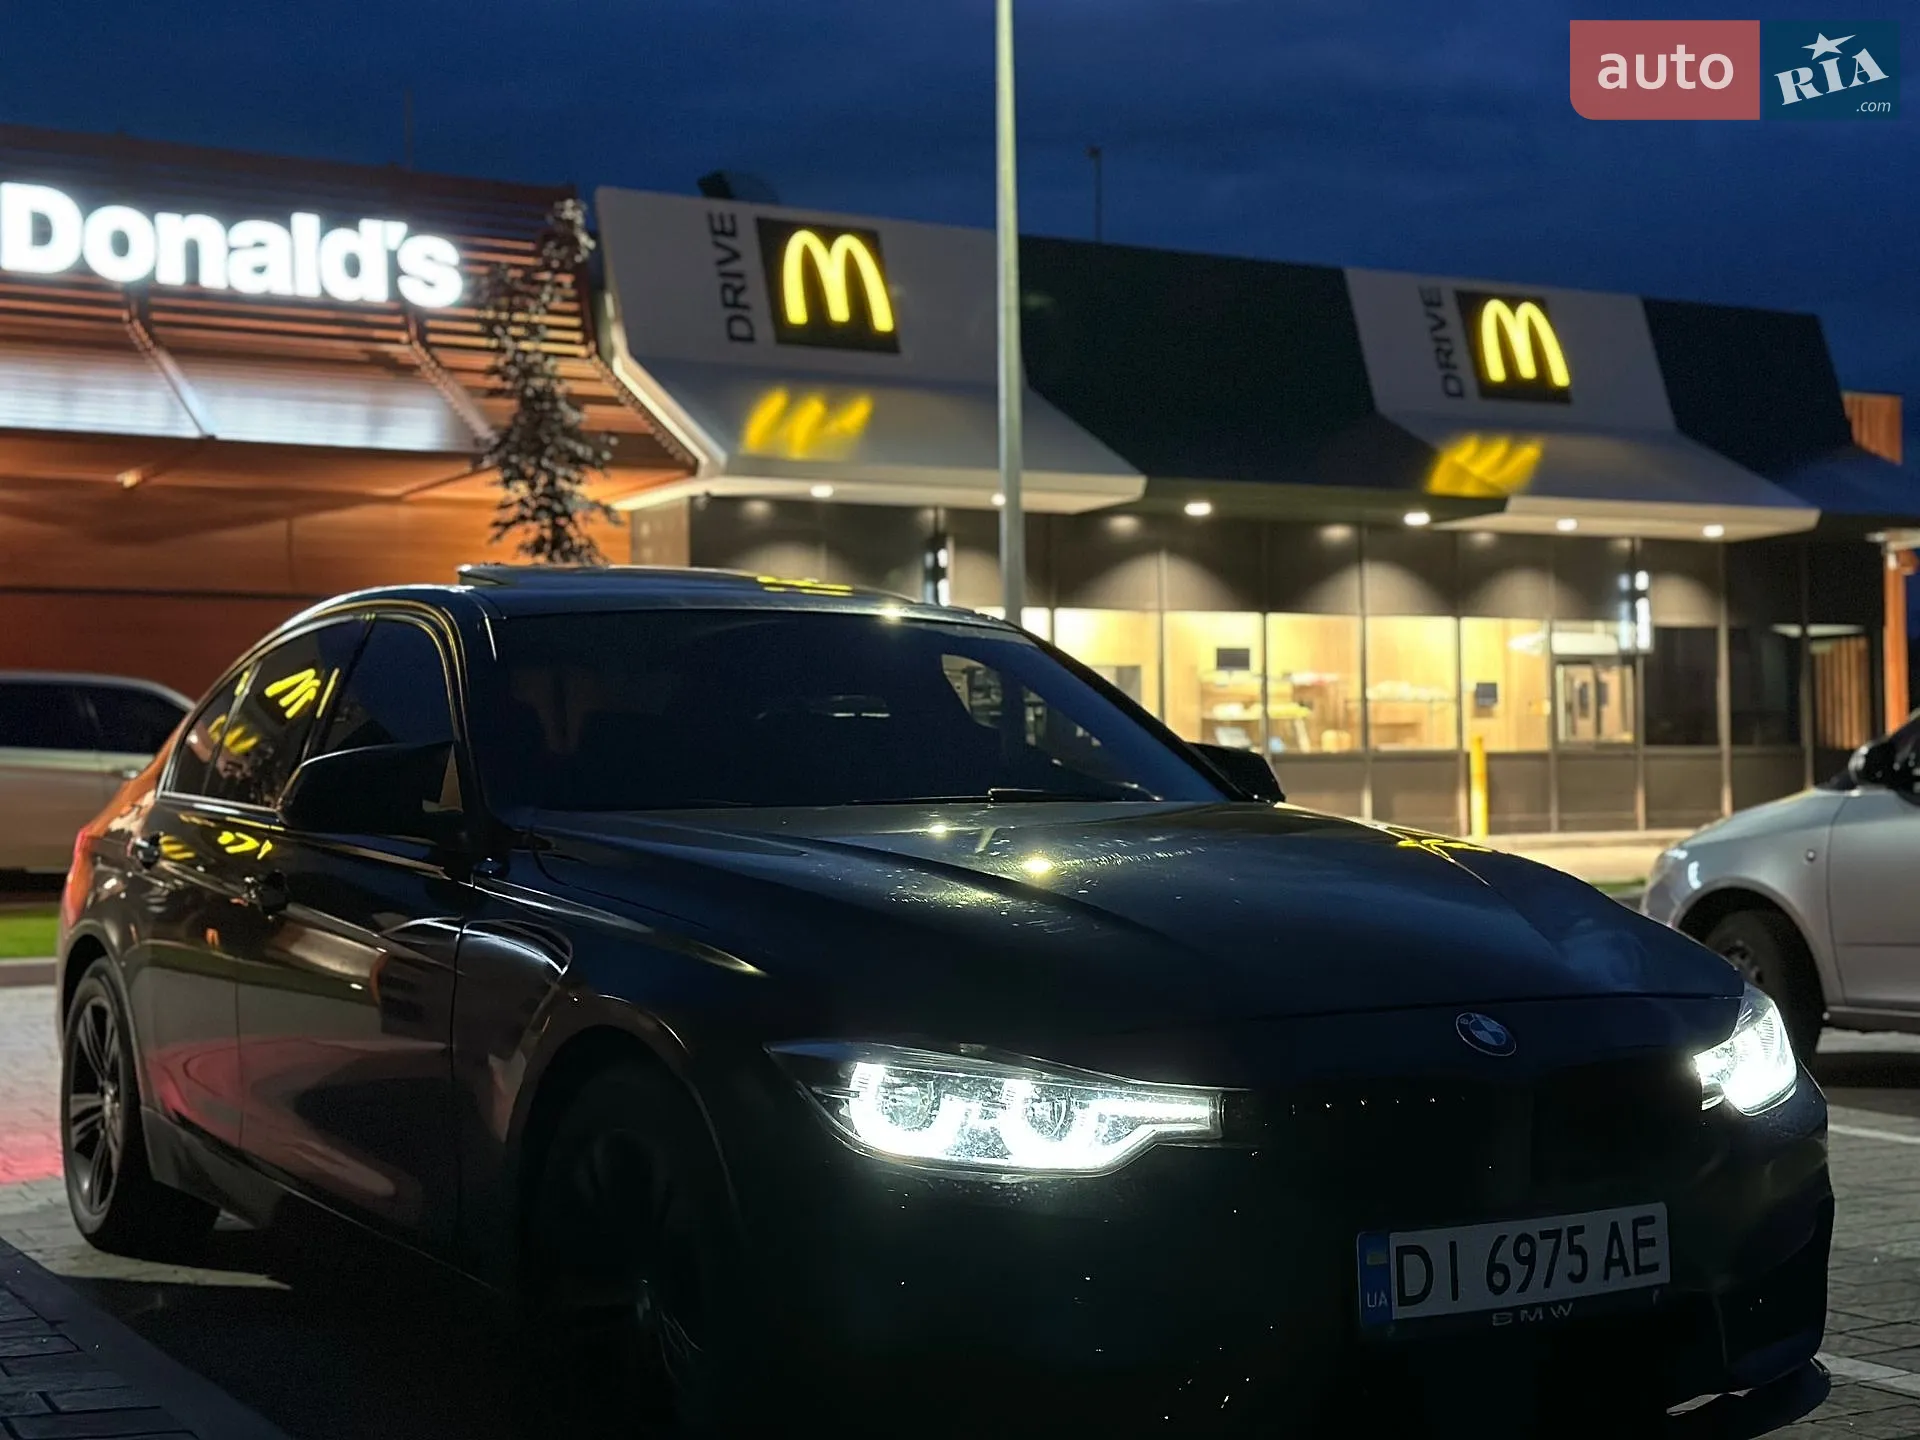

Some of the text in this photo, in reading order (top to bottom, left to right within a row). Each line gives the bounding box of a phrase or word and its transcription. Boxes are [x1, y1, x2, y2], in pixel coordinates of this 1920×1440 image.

[0, 181, 464, 309] Donald's
[707, 211, 756, 344] DRIVE
[1418, 285, 1465, 400] DRIVE
[1366, 1290, 1389, 1308] UA
[1395, 1215, 1660, 1307] DI 6975 AE
[1491, 1302, 1574, 1327] BMW
